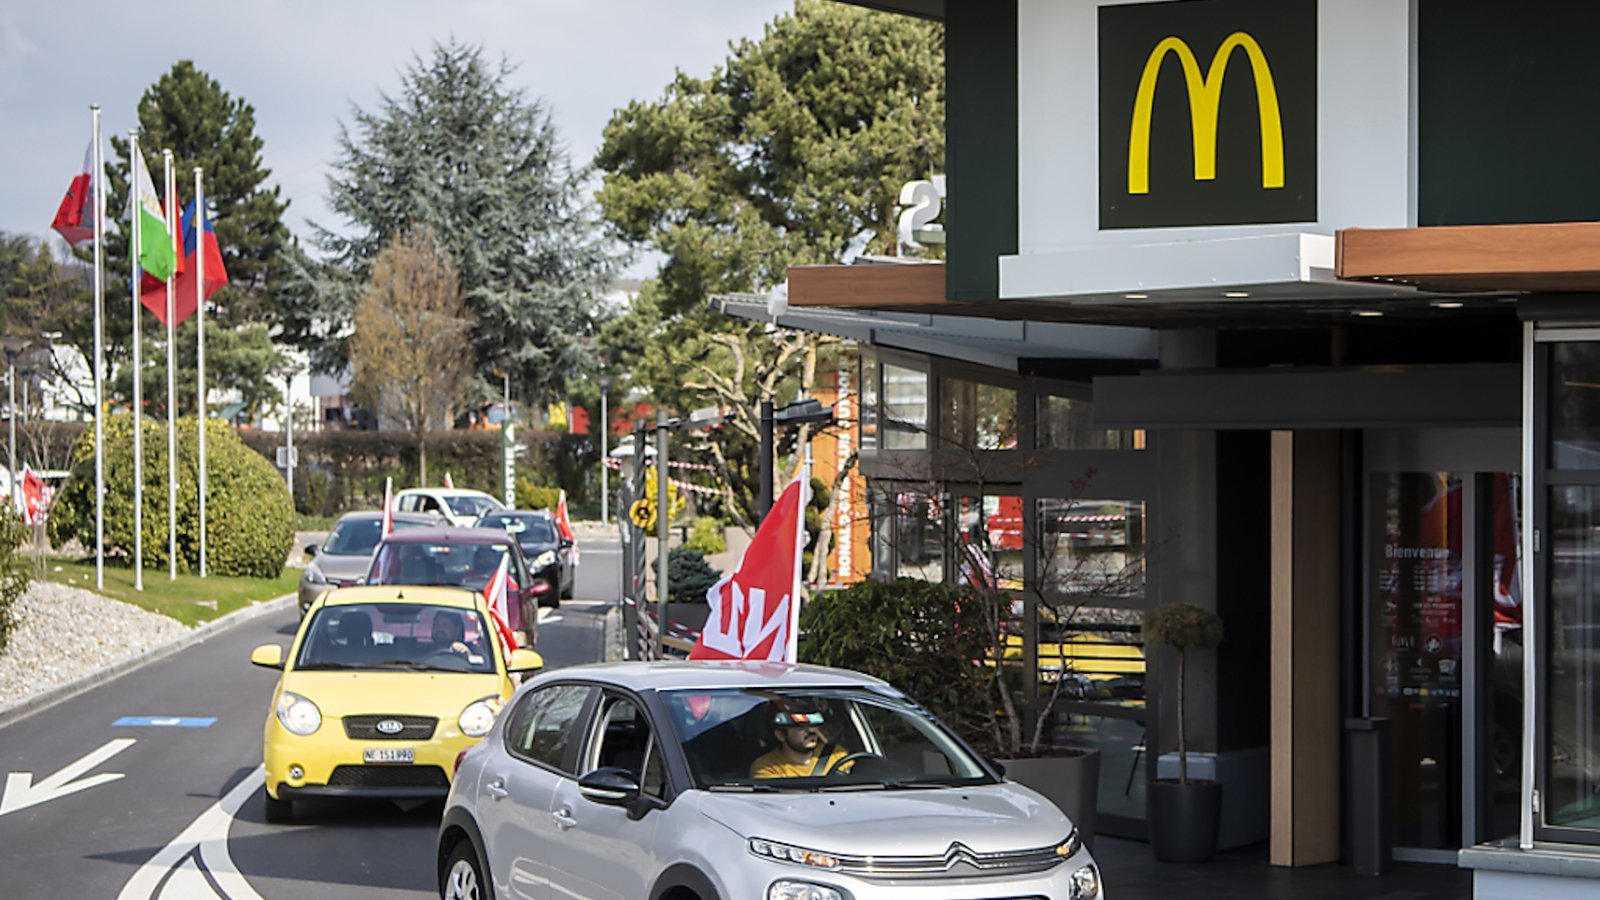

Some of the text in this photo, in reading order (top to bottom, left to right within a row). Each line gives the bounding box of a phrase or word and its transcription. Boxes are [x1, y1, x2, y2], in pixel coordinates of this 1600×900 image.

[1129, 32, 1284, 194] M
[838, 514, 851, 577] RONALD
[1385, 544, 1450, 558] Bienvenue
